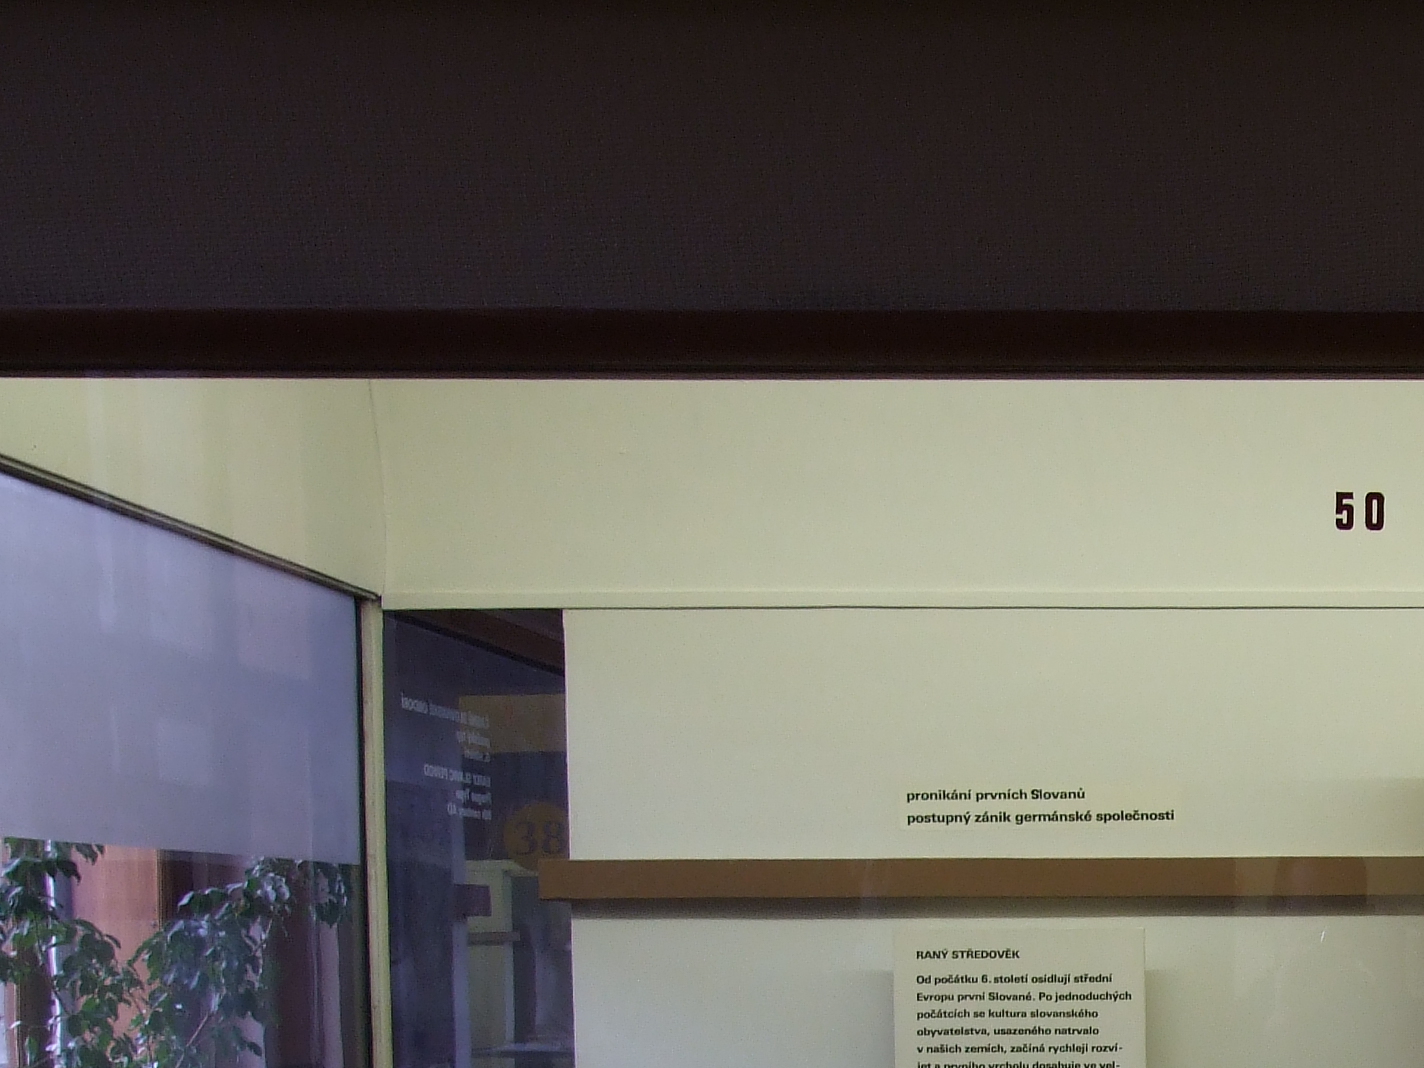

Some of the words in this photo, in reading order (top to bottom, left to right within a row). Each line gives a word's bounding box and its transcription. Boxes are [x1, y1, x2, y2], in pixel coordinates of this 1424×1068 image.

[1336, 492, 1385, 531] 50
[907, 789, 971, 803] pronikání
[976, 788, 1027, 803] prvních
[1031, 787, 1085, 800] Slovanů
[907, 811, 971, 826] postupný
[974, 811, 1012, 823] zánik
[1015, 810, 1092, 825] germánské
[1096, 809, 1174, 824] společnosti
[916, 948, 949, 960] RANÝ
[951, 948, 1020, 959] STŘEDOVĚK
[916, 975, 931, 984] Od
[934, 974, 978, 986] počátku
[981, 974, 992, 983] 6.
[994, 973, 1028, 984] století
[1031, 973, 1071, 985] osídlují
[1074, 973, 1112, 983] střední
[917, 992, 954, 1003] Evropu
[957, 991, 985, 1003] první
[988, 991, 1035, 1001] Slované.
[1039, 992, 1052, 1001] Po
[1054, 991, 1132, 1003] jednoduchých
[917, 1009, 970, 1021] počátcích
[988, 1009, 1027, 1018] kultura
[1030, 1008, 1098, 1018] slovanského
[917, 1026, 990, 1038] obyvatelstva,
[994, 1026, 1051, 1035] usazeného
[1054, 1026, 1099, 1035] natrvalo
[927, 1044, 962, 1053] našich
[965, 1043, 1007, 1054] zemích,
[1010, 1043, 1045, 1053] začíná
[1048, 1043, 1088, 1055] rychleji
[1091, 1042, 1123, 1052] rozví-
